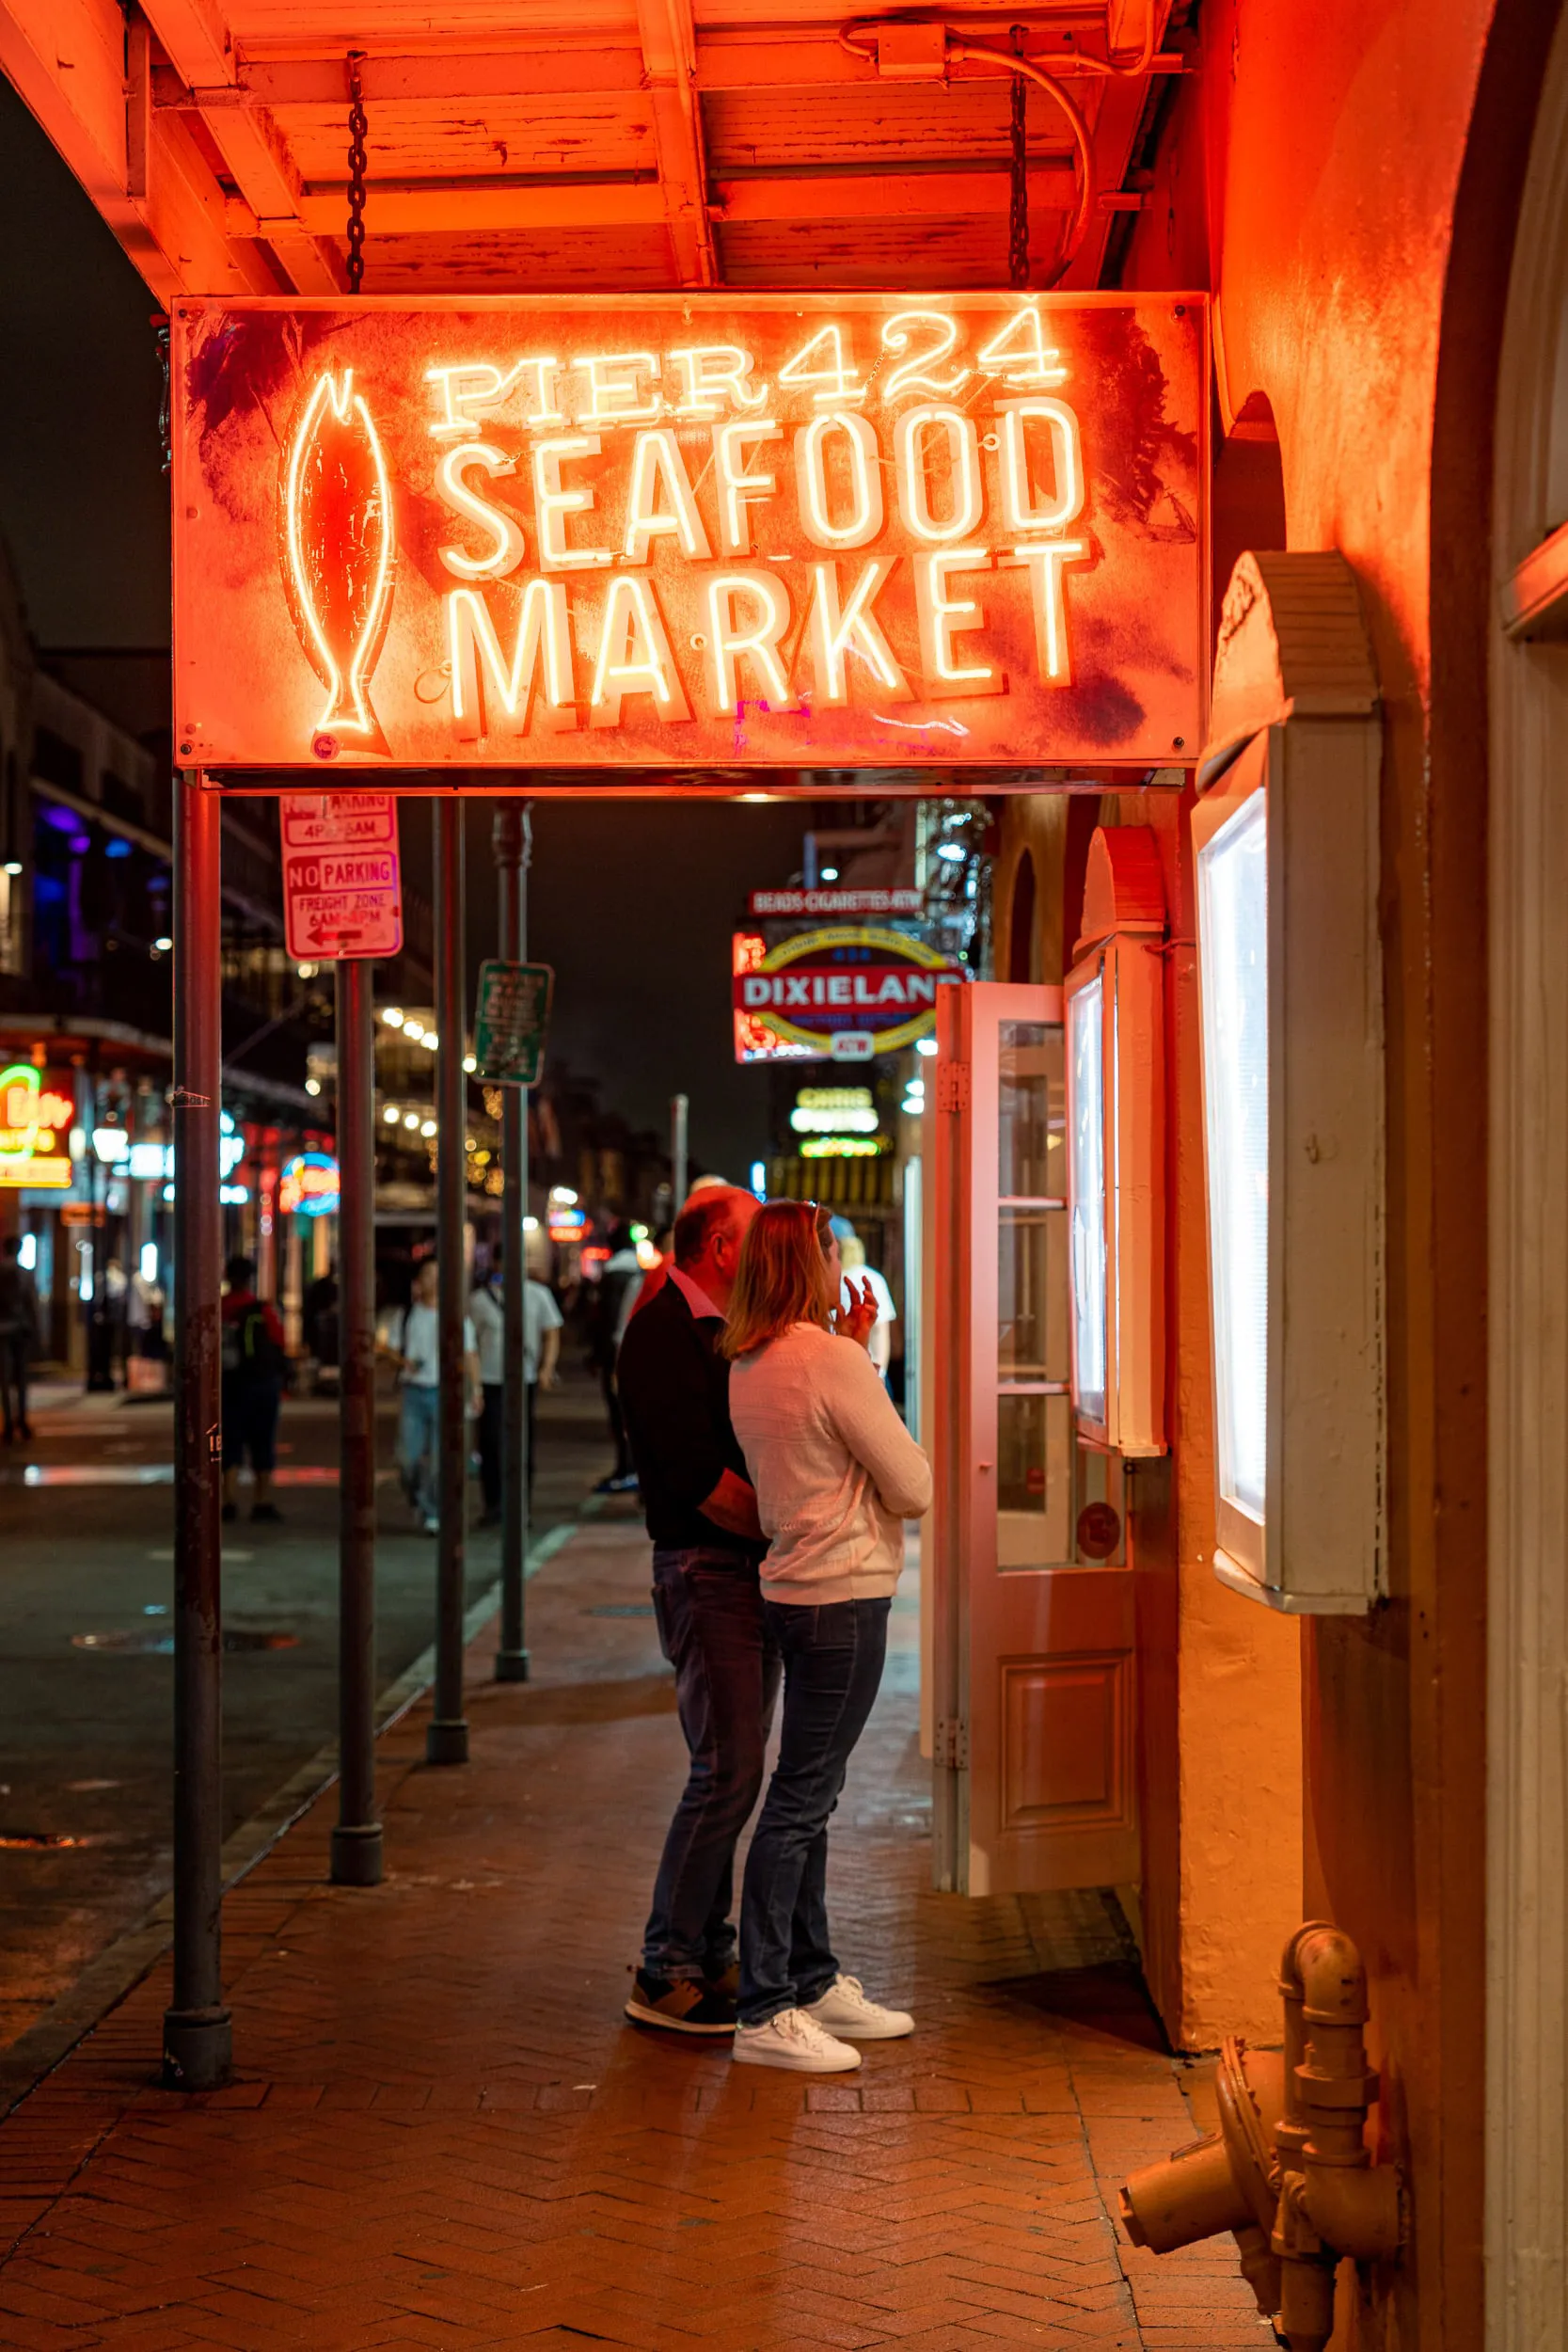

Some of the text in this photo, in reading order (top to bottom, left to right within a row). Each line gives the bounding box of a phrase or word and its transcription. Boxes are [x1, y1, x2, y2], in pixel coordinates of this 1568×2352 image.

[423, 306, 1069, 440] PIER 424
[434, 396, 1085, 580] SEAFOOD
[437, 537, 1091, 739] MARKET
[325, 796, 387, 810] ARKING
[289, 861, 390, 888] NO PARKING
[299, 893, 387, 912] FREIGHT ZONE
